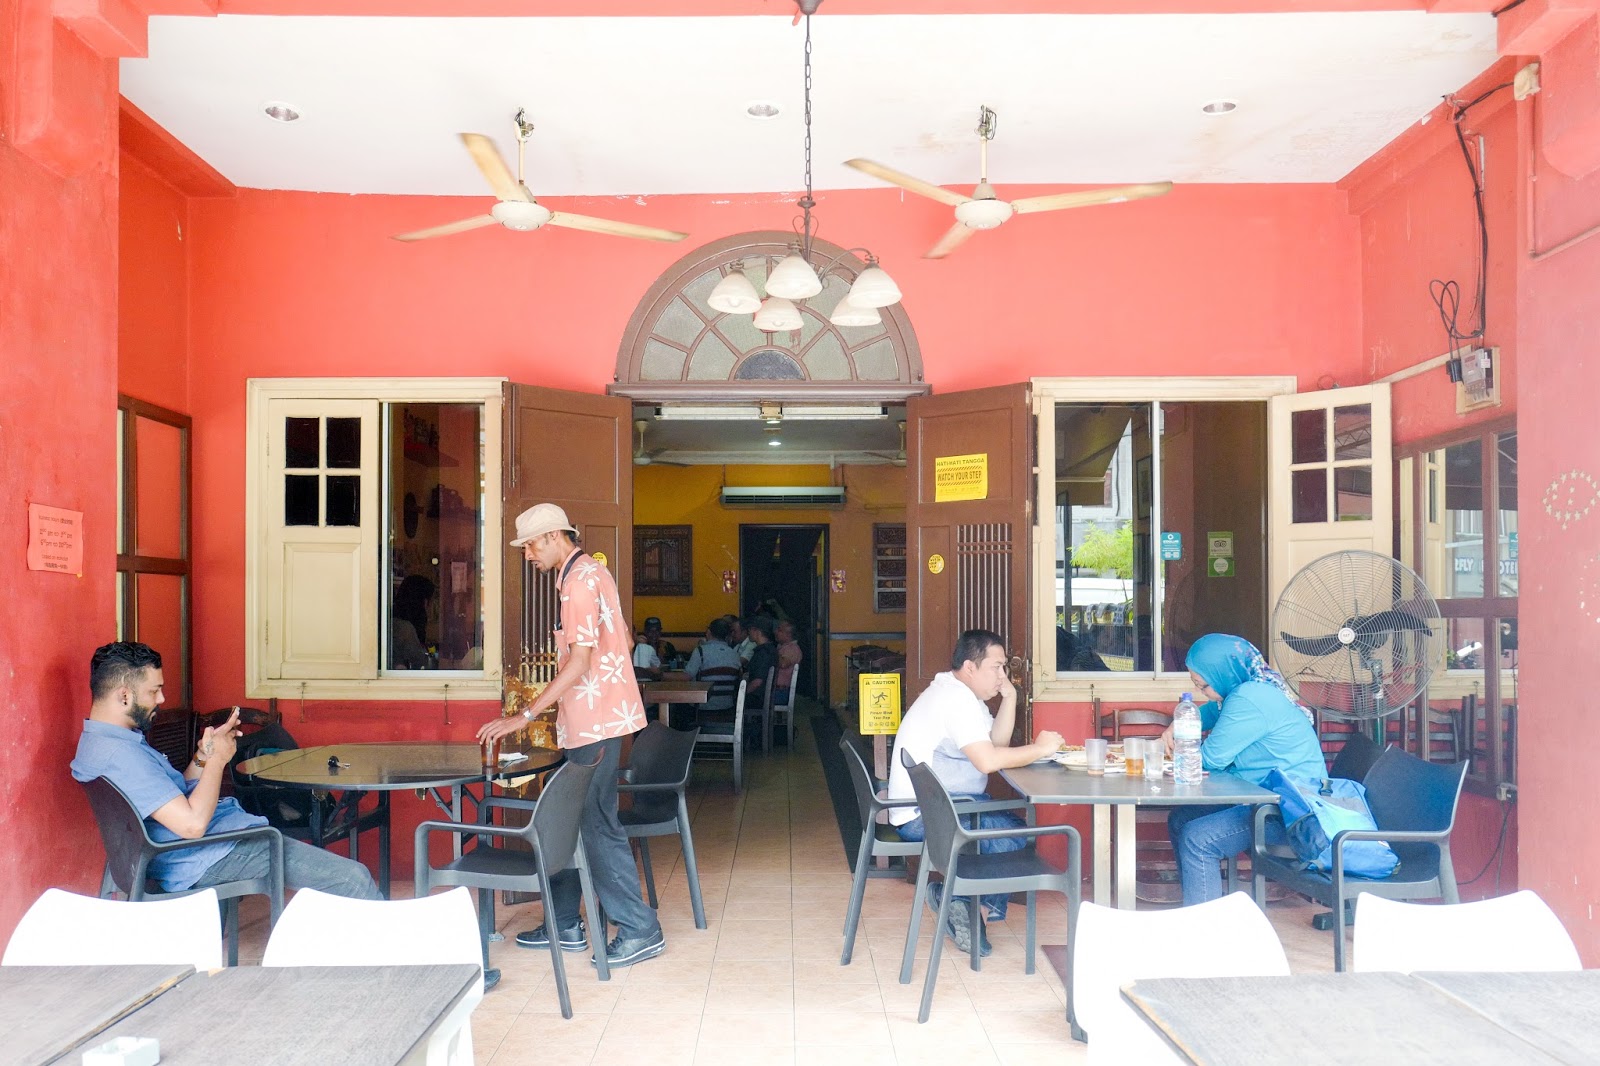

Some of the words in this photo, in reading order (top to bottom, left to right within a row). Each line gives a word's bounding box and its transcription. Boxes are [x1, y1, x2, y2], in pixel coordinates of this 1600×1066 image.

[938, 472, 954, 481] WATCH
[955, 471, 968, 480] YOUR
[969, 470, 982, 479] STEP
